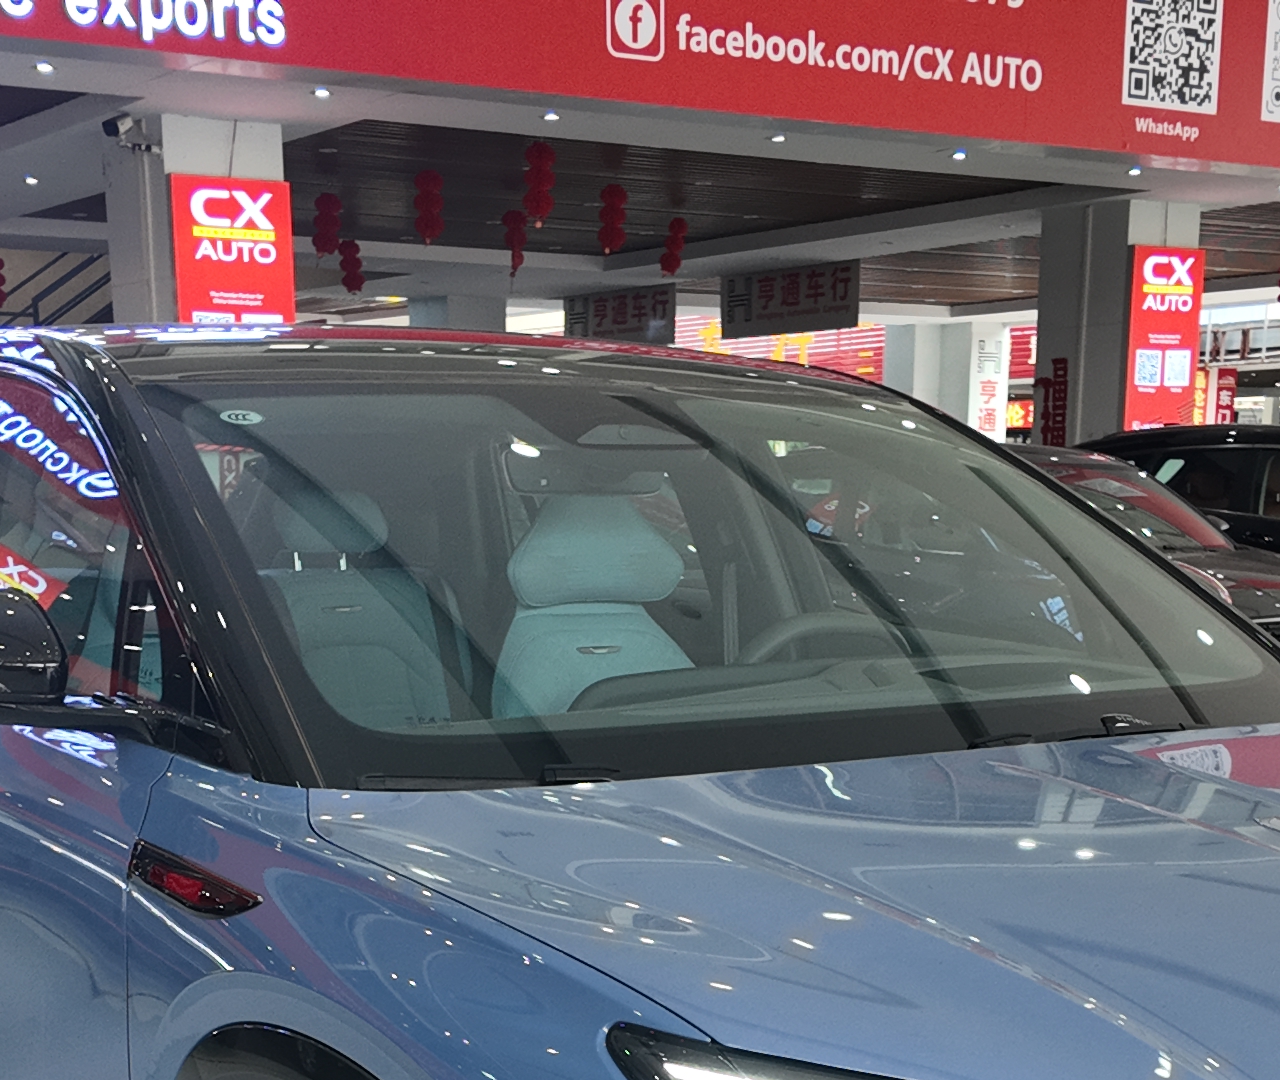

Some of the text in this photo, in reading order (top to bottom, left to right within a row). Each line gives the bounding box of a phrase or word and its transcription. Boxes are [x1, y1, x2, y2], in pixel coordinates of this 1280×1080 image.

[65, 0, 287, 46] exports
[676, 13, 1043, 92] facebook.com/CX AUTO
[1135, 116, 1200, 142] WhatsApp
[190, 188, 275, 230] CX
[194, 239, 277, 264] AUTO
[1143, 255, 1196, 286] CX
[1141, 293, 1193, 312] AUTO
